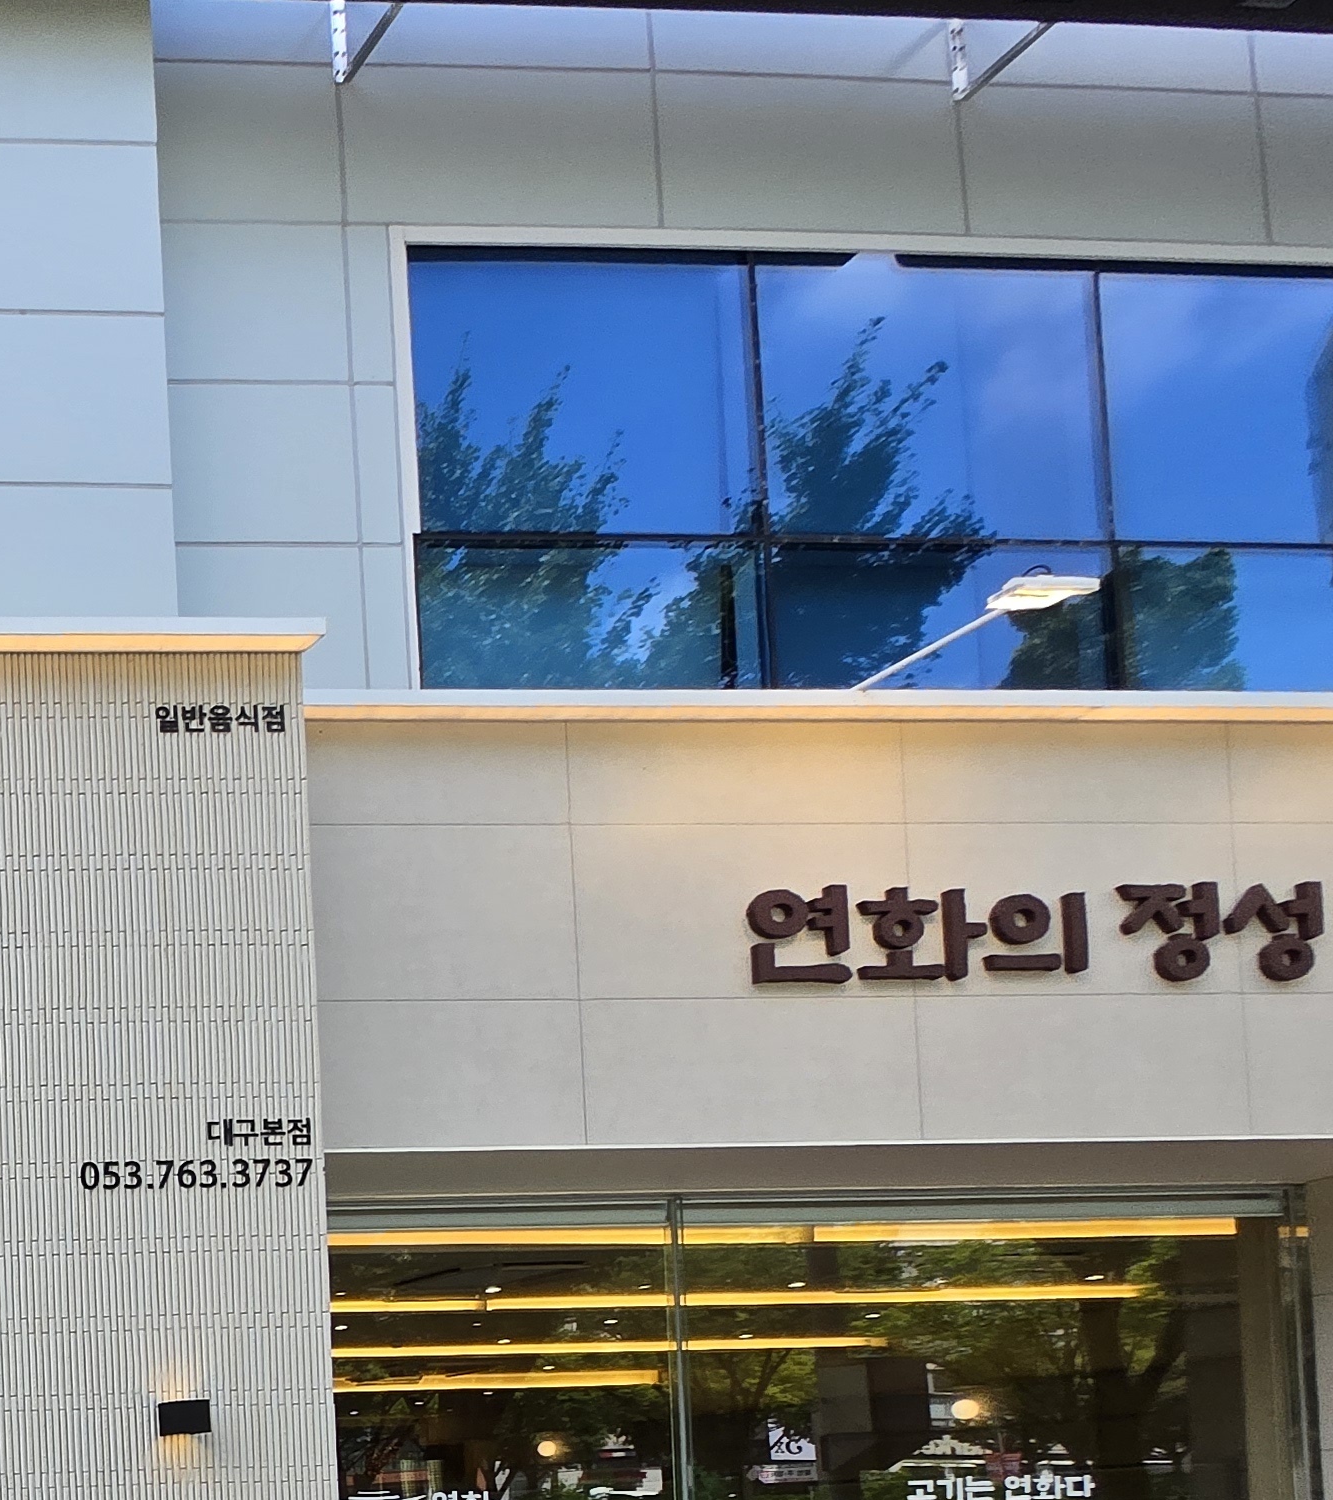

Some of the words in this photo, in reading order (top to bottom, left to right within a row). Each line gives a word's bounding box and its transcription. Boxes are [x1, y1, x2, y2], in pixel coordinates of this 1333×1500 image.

[155, 703, 286, 733] 일반음식점
[745, 883, 1090, 985] 연화의
[1114, 880, 1325, 983] 정성
[206, 1117, 312, 1147] 대구본점
[80, 1158, 313, 1190] 053.763.3737
[1004, 1474, 1096, 1500] 연화다
